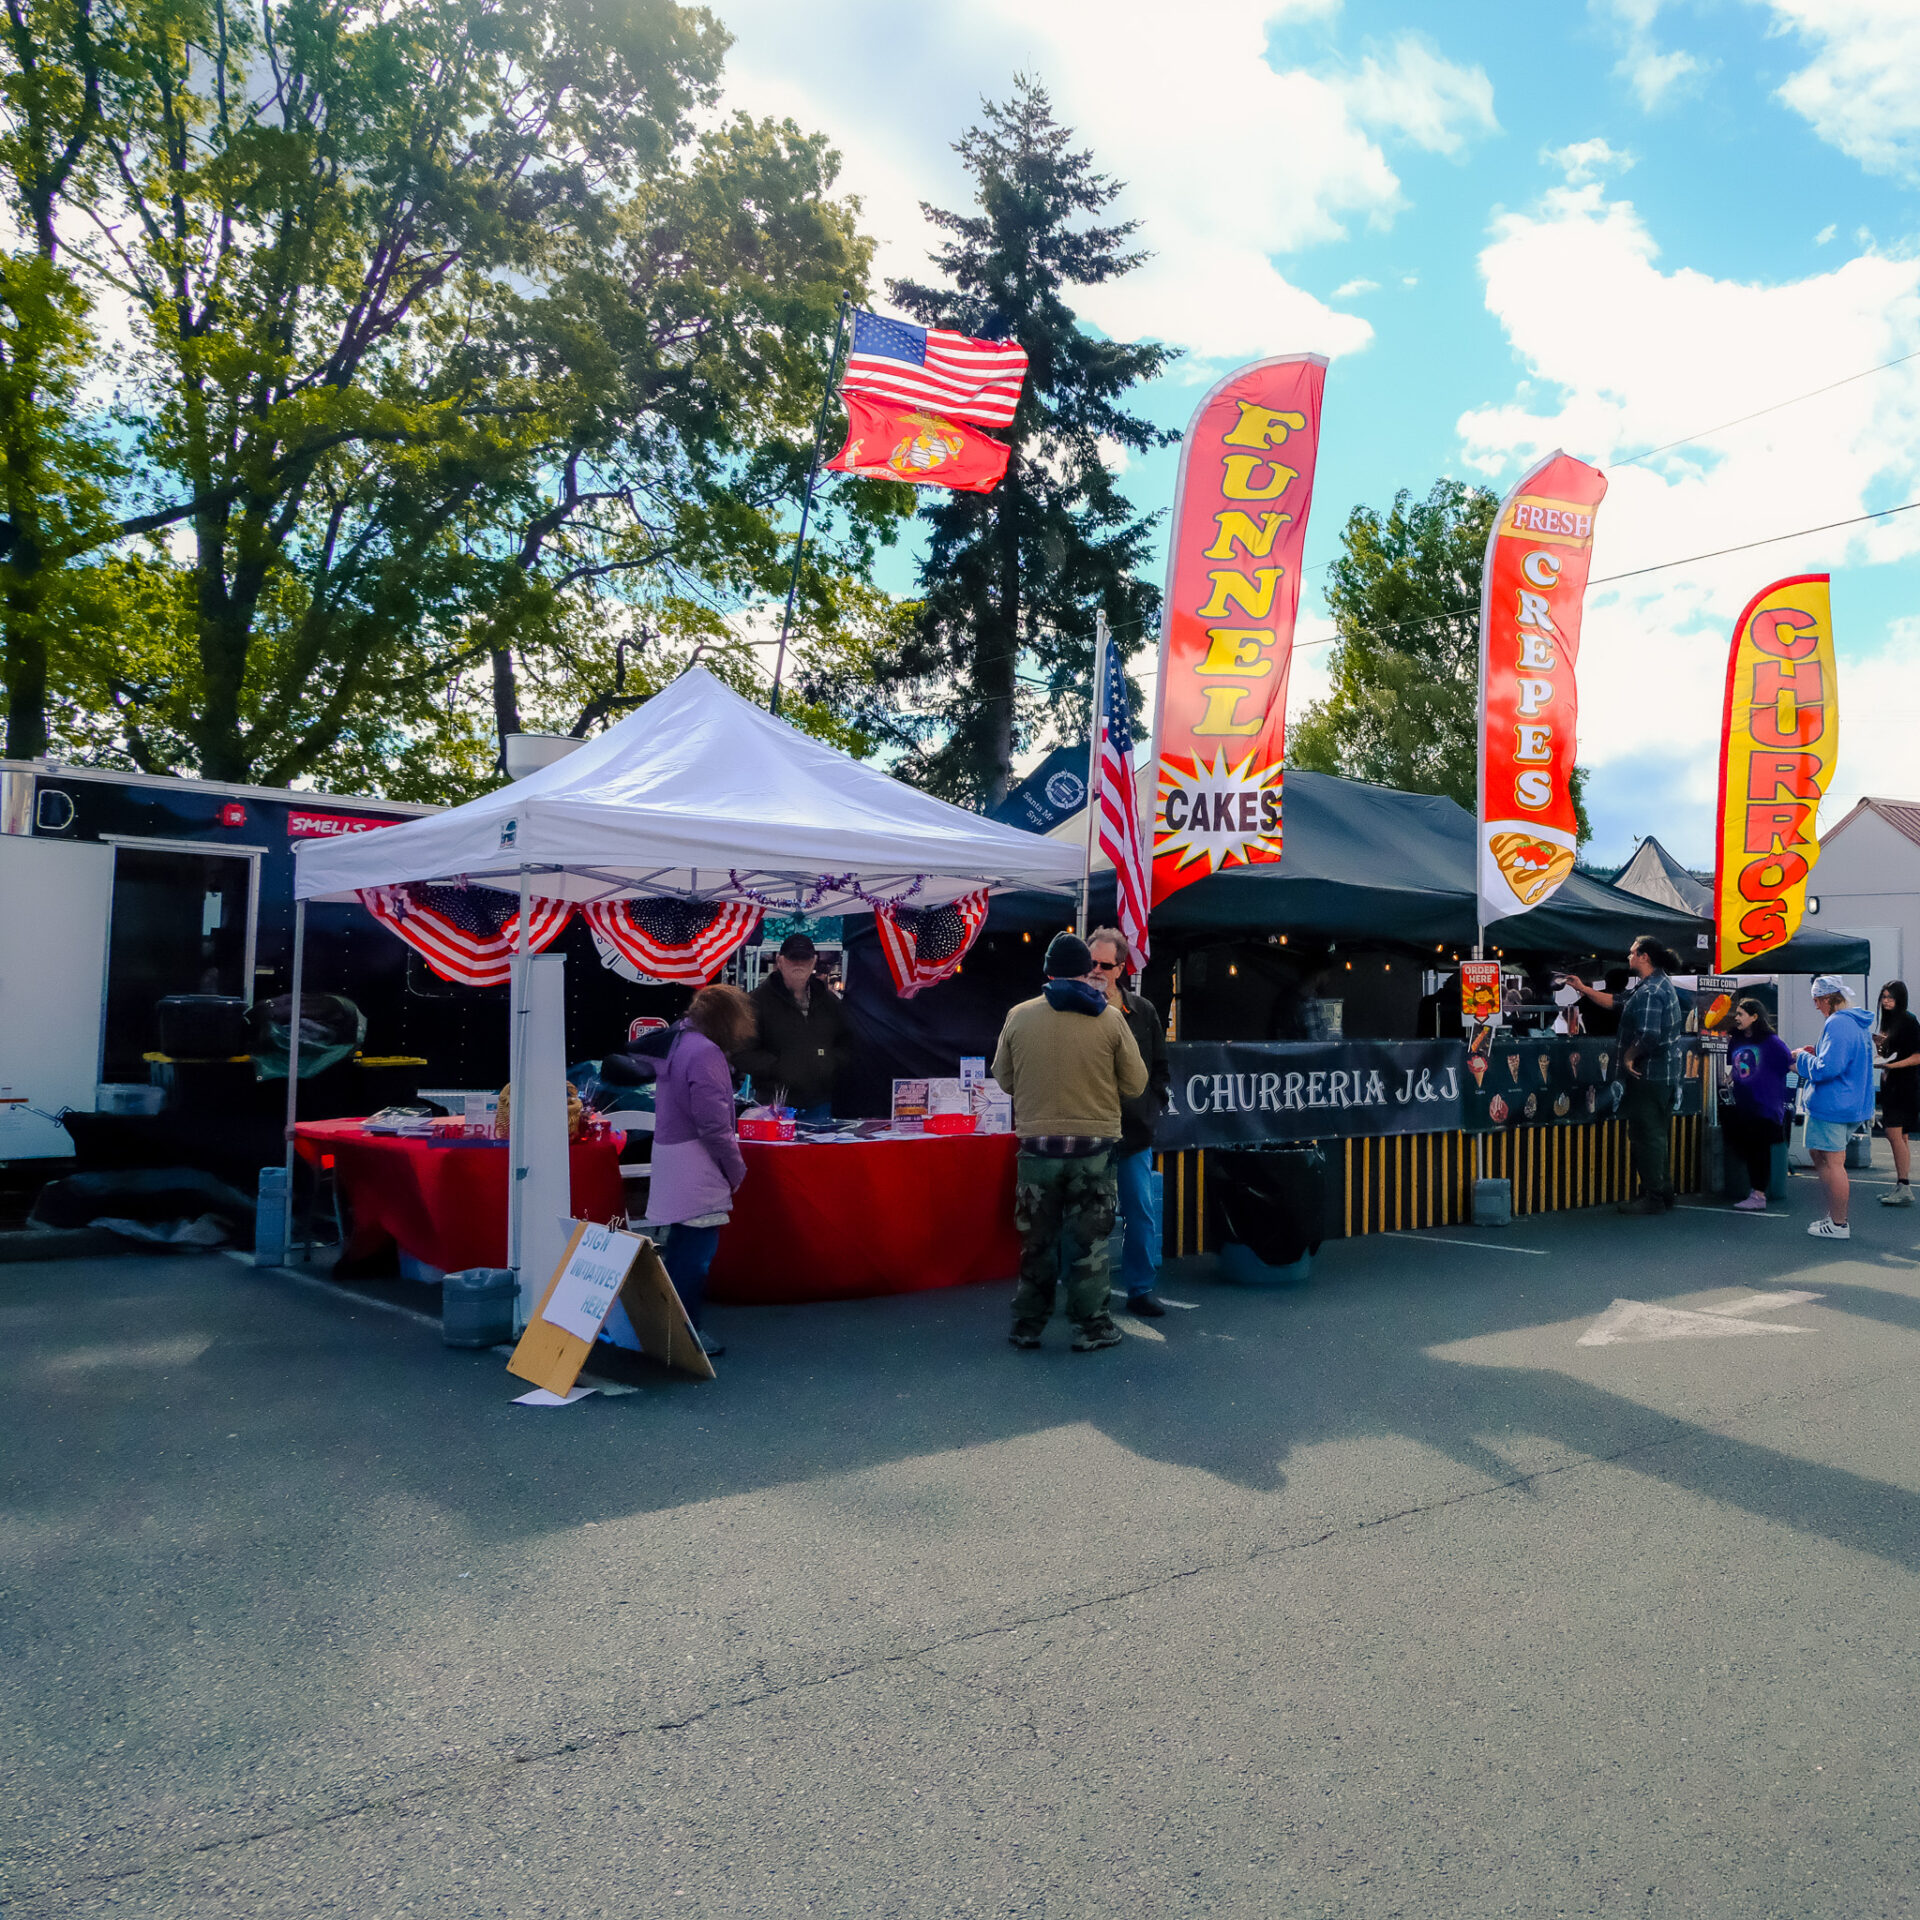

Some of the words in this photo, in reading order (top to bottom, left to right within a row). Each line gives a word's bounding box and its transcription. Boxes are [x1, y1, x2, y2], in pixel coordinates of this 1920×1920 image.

[1513, 503, 1592, 537] FRESH
[1193, 400, 1308, 737] FUNNEL
[1513, 549, 1564, 812] CREPES
[1737, 608, 1825, 955] CHURROS
[1022, 791, 1044, 812] Santa
[1165, 789, 1278, 832] CAKES
[292, 817, 367, 834] SMELLS
[1464, 966, 1496, 975] ORDER
[1469, 974, 1493, 983] HERE
[1699, 978, 1720, 987] STREET
[1720, 979, 1737, 988] CORN
[1186, 1070, 1388, 1114] CHURRERIA
[1395, 1067, 1460, 1104] J&J
[581, 1229, 612, 1252] SIGN
[580, 1296, 611, 1320] HERE
